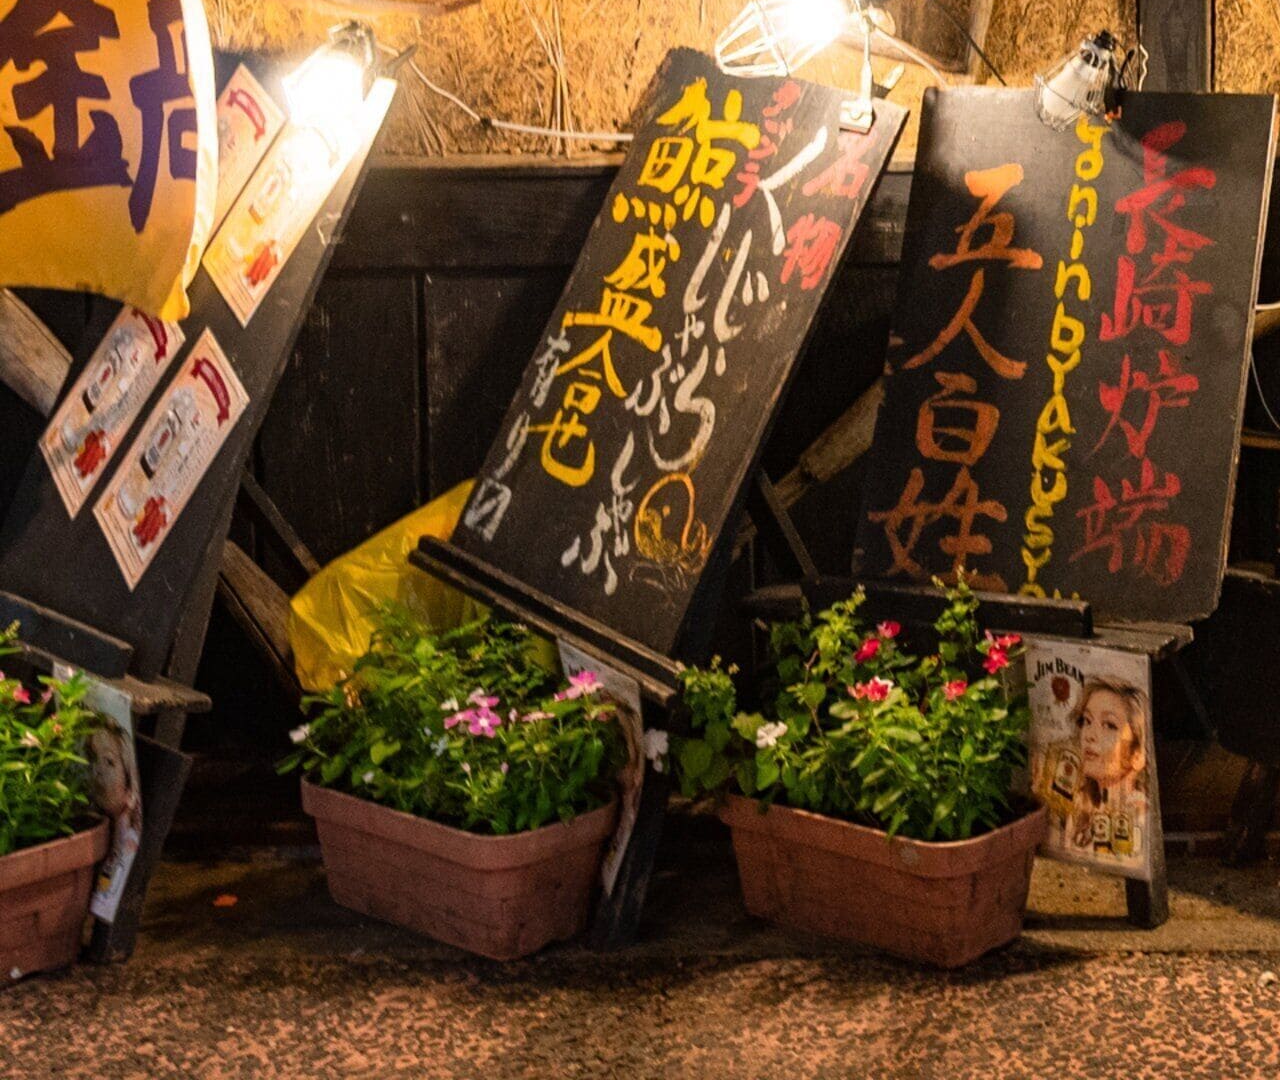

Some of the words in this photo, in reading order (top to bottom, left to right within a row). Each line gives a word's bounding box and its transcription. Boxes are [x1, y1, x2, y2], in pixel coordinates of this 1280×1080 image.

[867, 162, 1044, 593] 五人百姓
[1034, 660, 1055, 683] JIM
